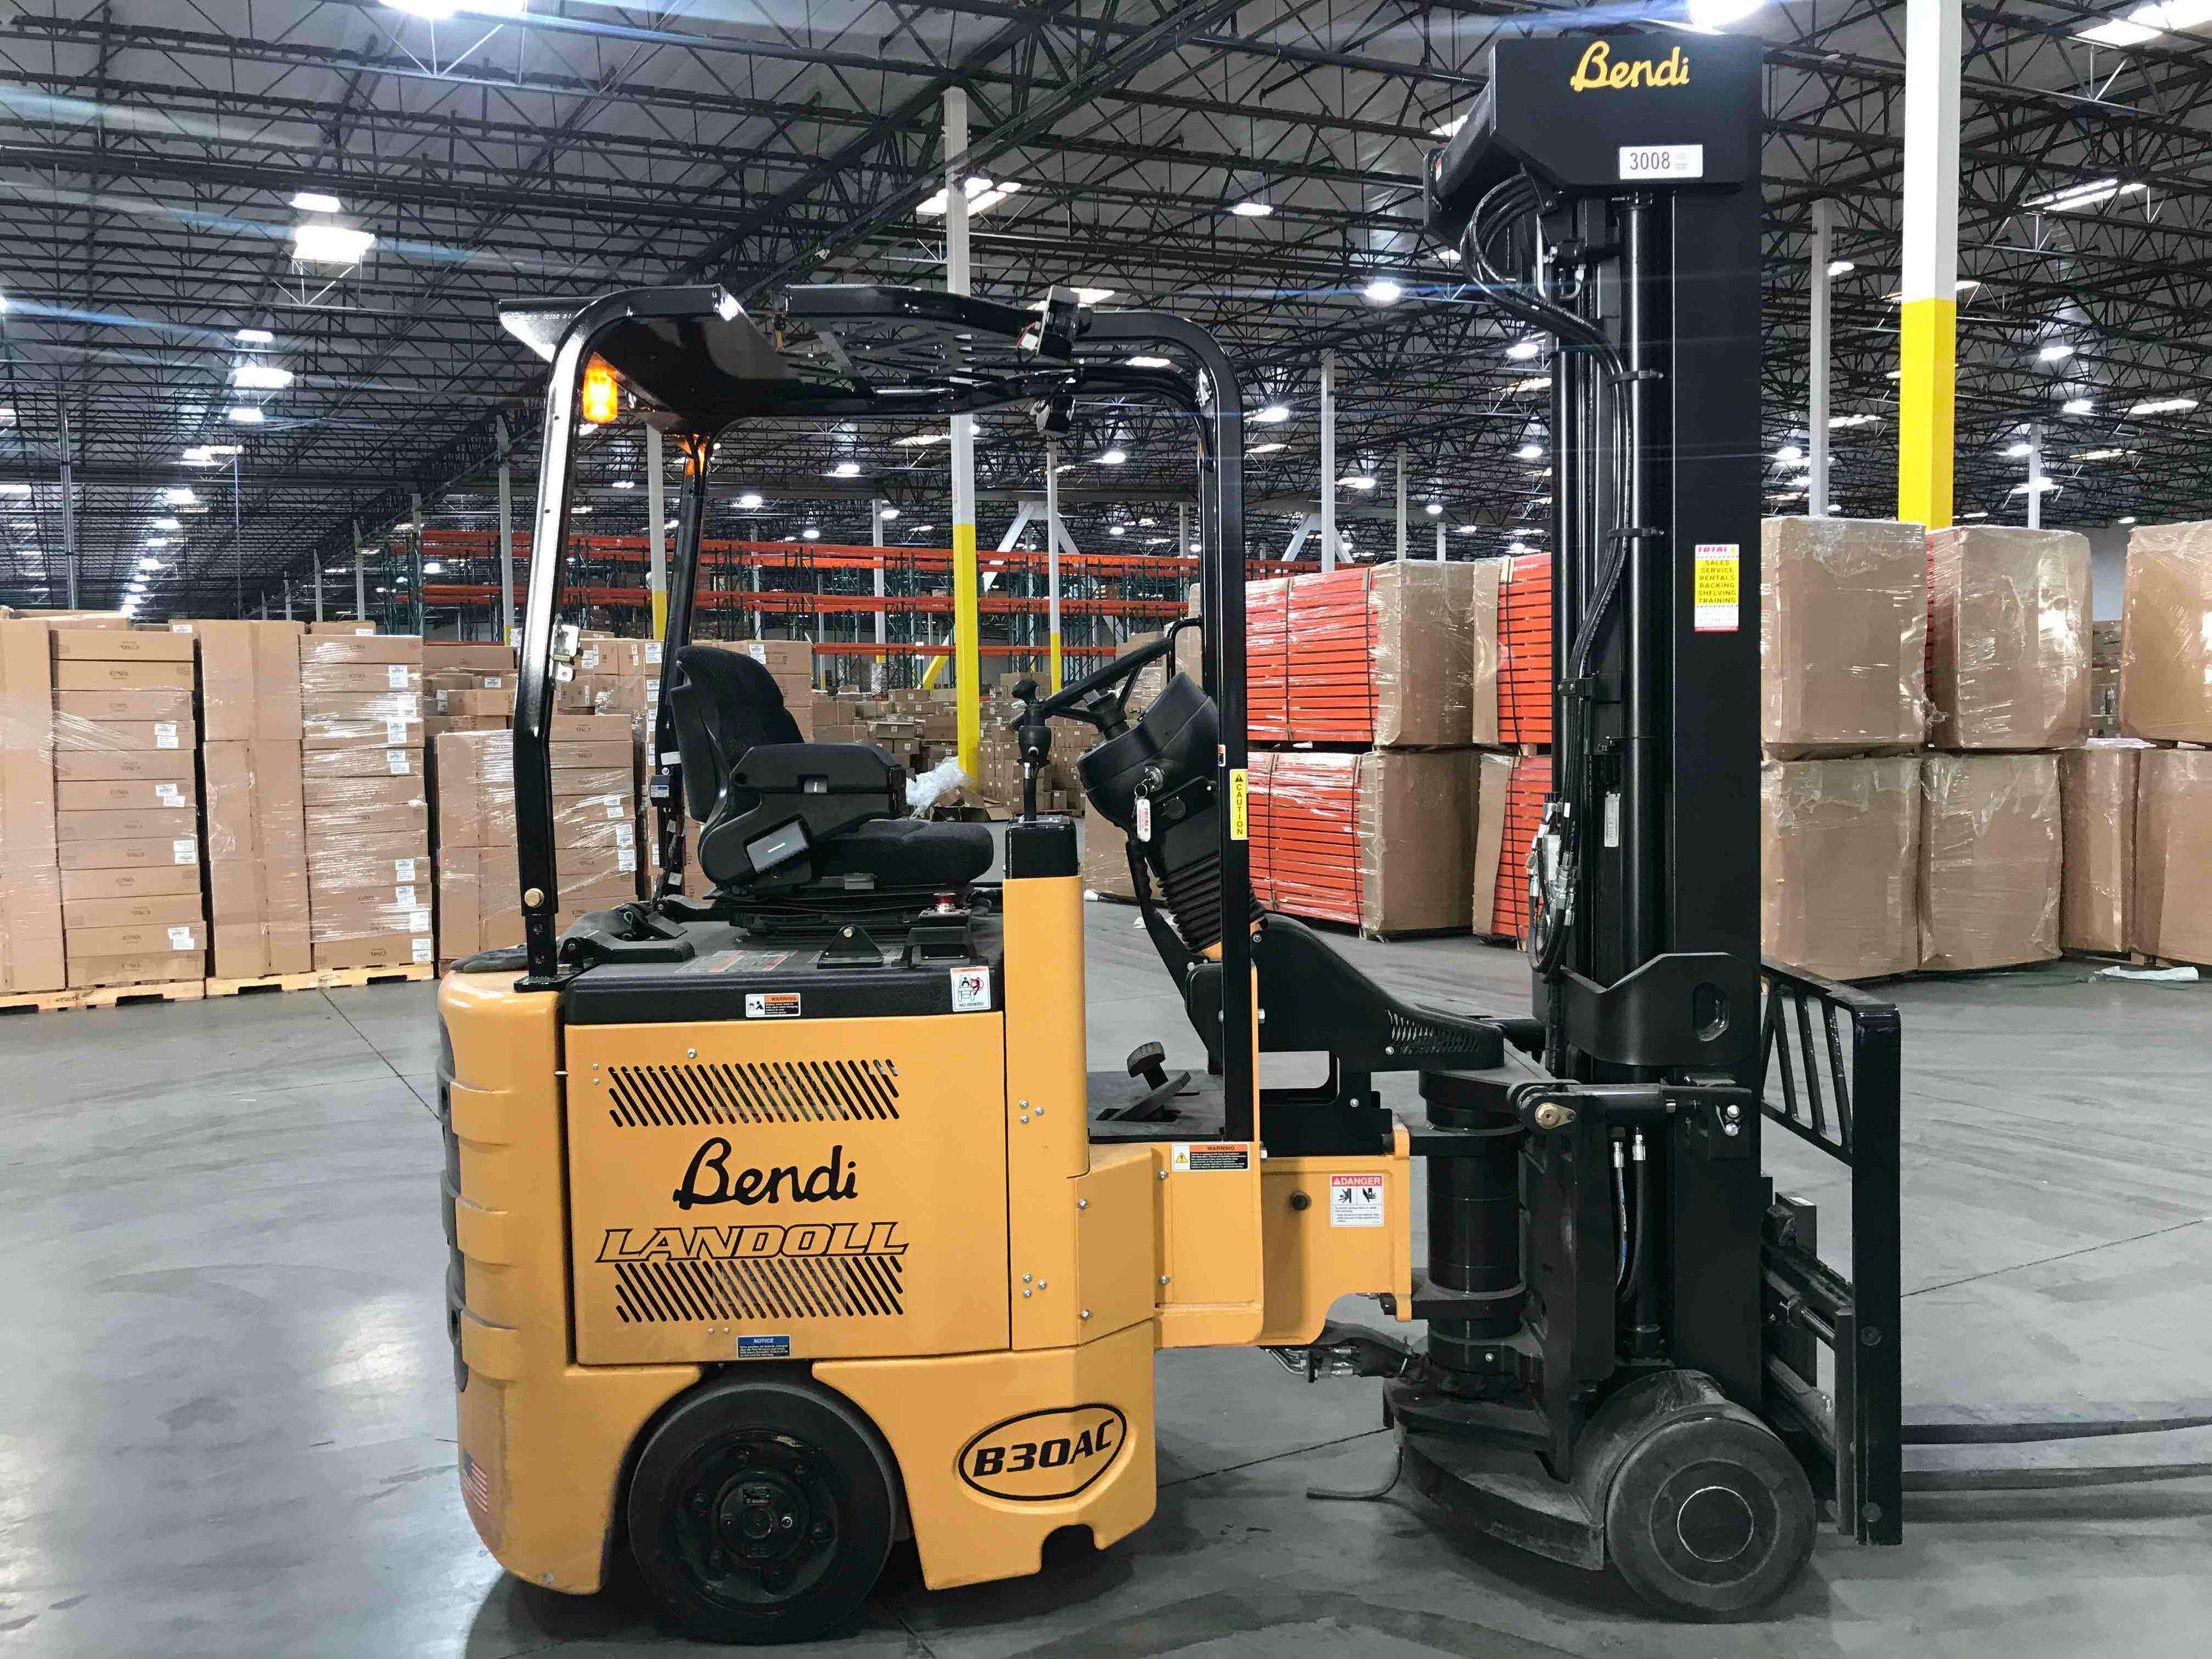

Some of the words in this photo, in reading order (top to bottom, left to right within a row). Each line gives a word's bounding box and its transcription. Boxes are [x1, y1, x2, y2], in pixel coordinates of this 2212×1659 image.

[1570, 41, 1690, 92] Bendi
[1630, 151, 1670, 170] 3008
[672, 1137, 858, 1210] Bendi
[594, 1222, 910, 1263] LANDOLL
[973, 1418, 1114, 1477] B30AC
